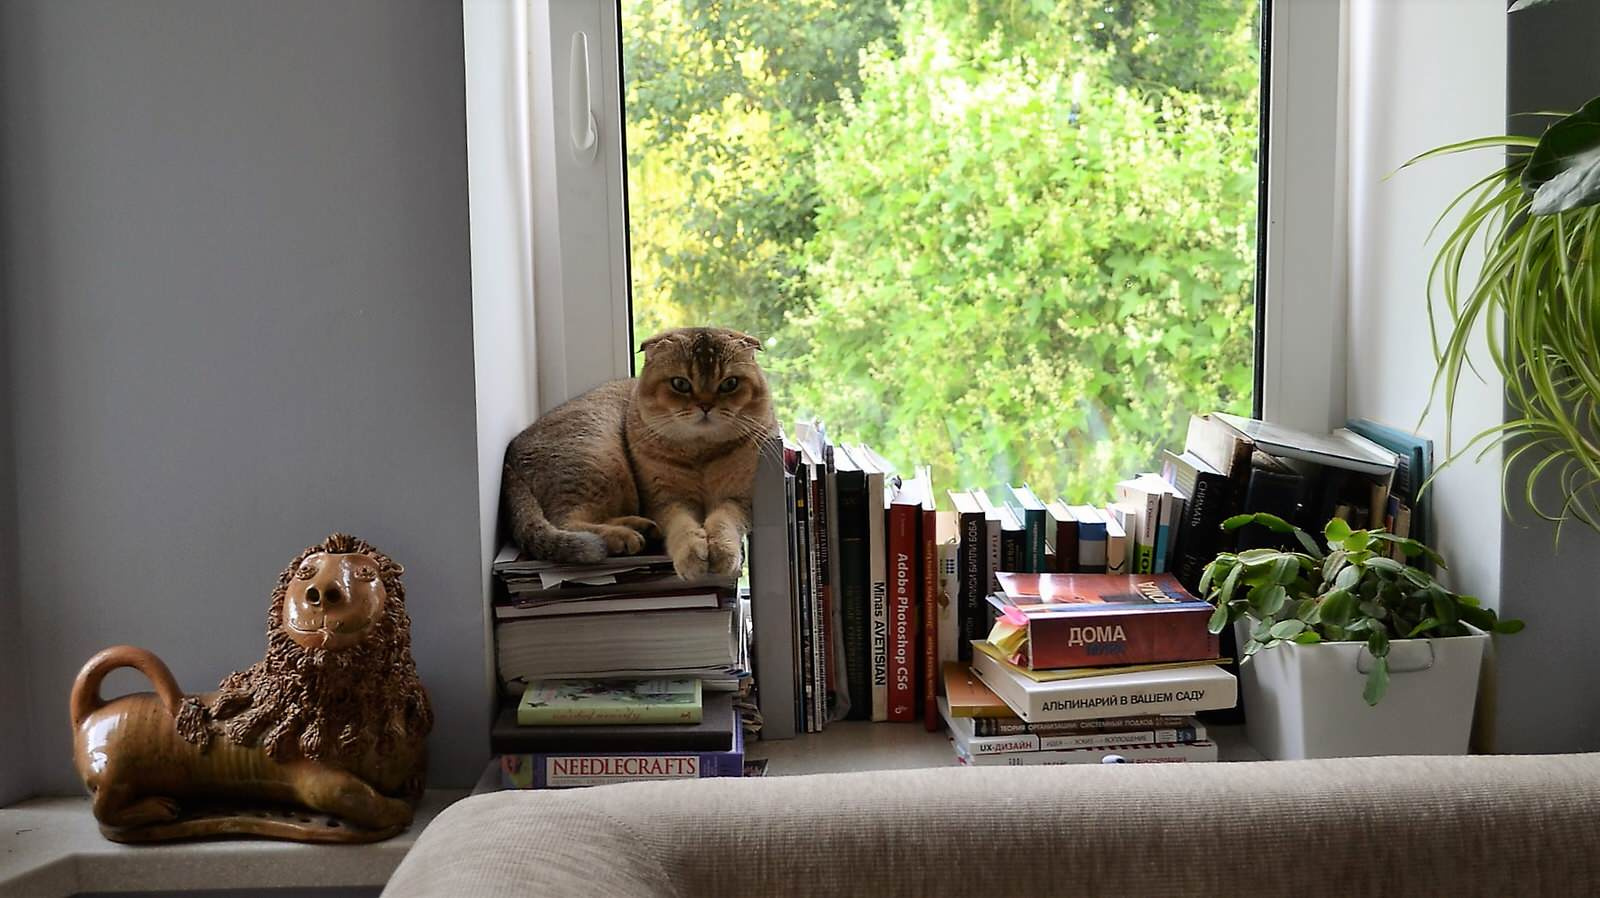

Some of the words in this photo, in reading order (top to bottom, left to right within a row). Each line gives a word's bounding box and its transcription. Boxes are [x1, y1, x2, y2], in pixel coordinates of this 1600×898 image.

[1191, 480, 1209, 528] СНИМАТЬ
[970, 520, 978, 542] БОБА
[969, 544, 978, 573] БИЛЛИ
[897, 553, 908, 594] Adobe
[874, 582, 885, 617] Minas
[969, 574, 978, 608] ЗАПИСИ
[894, 596, 908, 664] Photoshop
[1068, 625, 1127, 647] ДОМА
[874, 620, 886, 686] AVETISIAN
[897, 667, 908, 690] CS6
[1042, 694, 1117, 712] АЛЬПИНАРИЙ
[1120, 695, 1128, 706] В
[1131, 692, 1173, 705] ВАШЕМ
[1175, 690, 1205, 702] САДУ
[1000, 724, 1025, 732] ТЕОРИЯ
[1080, 718, 1123, 729] СИСТЕМНЫЙ
[1124, 718, 1153, 727] ПОДХОД
[980, 741, 1032, 752] UX-ДИЗАЙН
[553, 757, 696, 775] NEEDLECRAFTS
